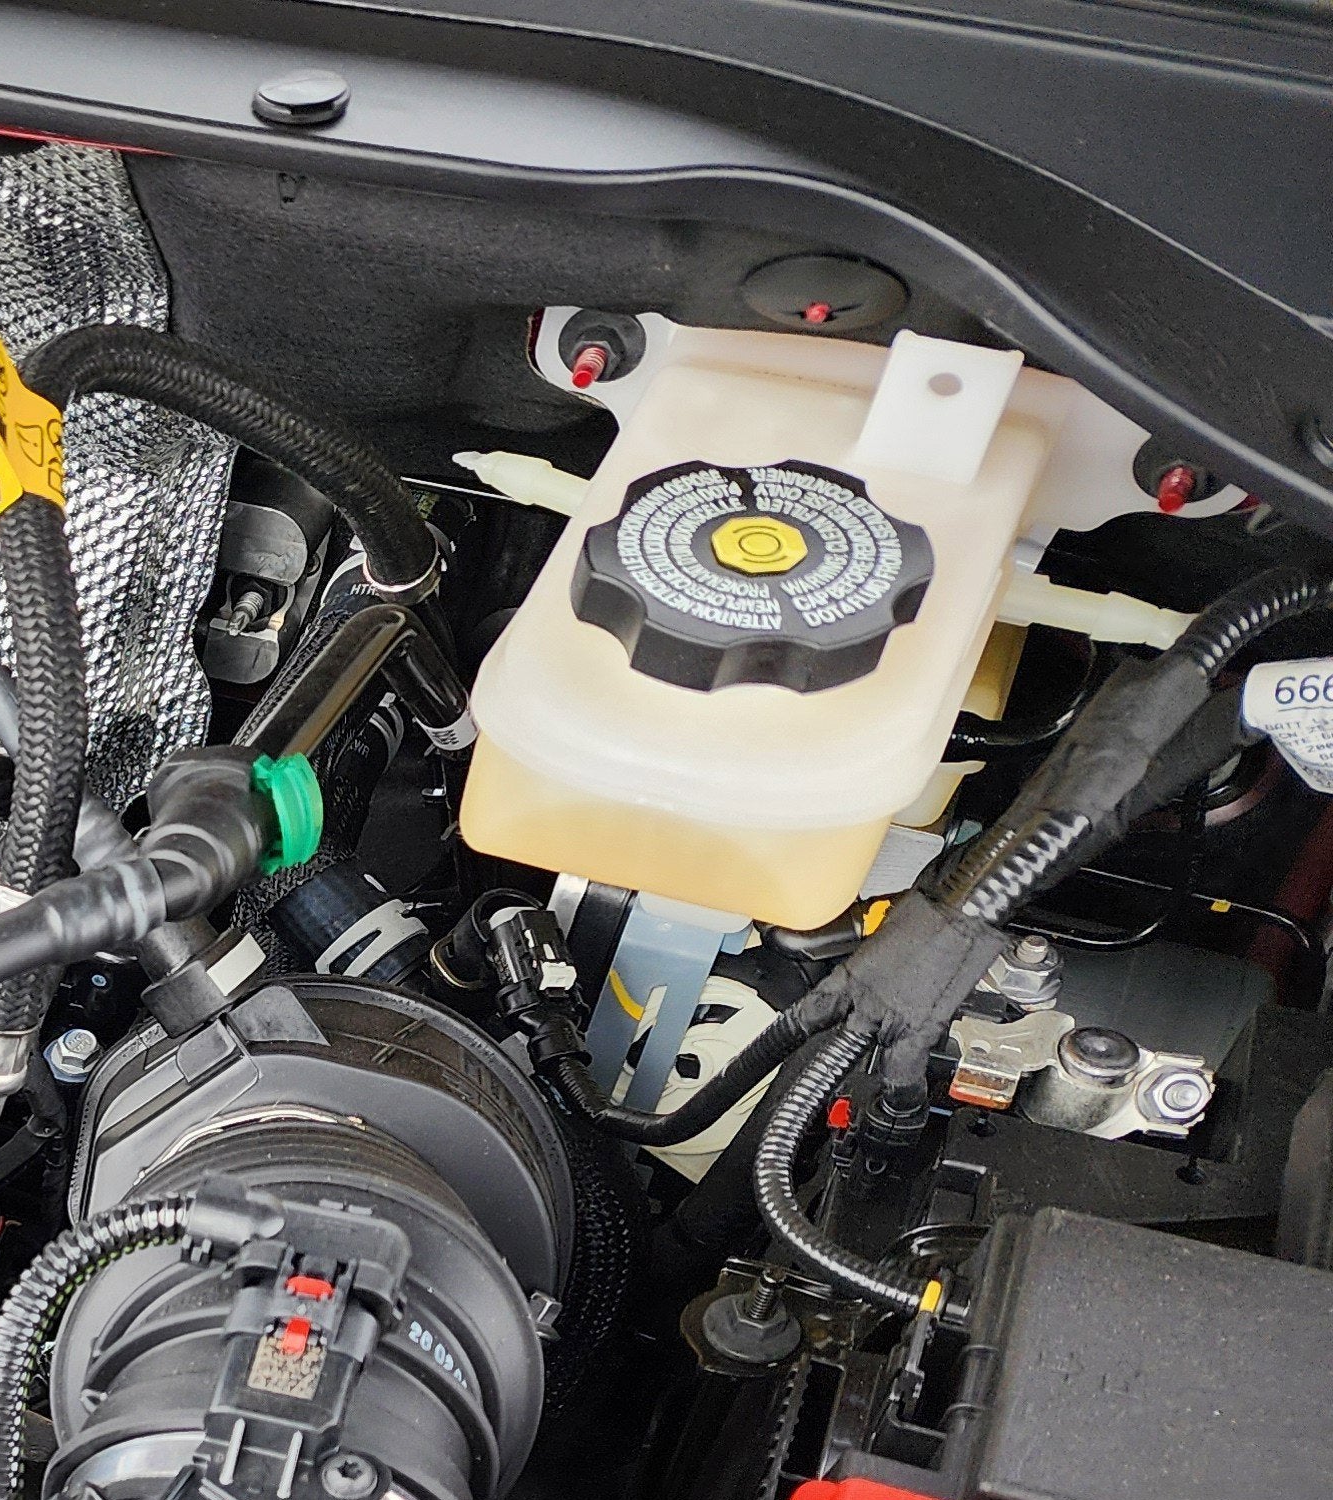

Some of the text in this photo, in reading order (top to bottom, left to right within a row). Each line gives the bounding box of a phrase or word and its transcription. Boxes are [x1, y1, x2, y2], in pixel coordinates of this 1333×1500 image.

[752, 479, 802, 502] ONLY
[756, 496, 818, 520] FILLER
[791, 590, 840, 612] CAP
